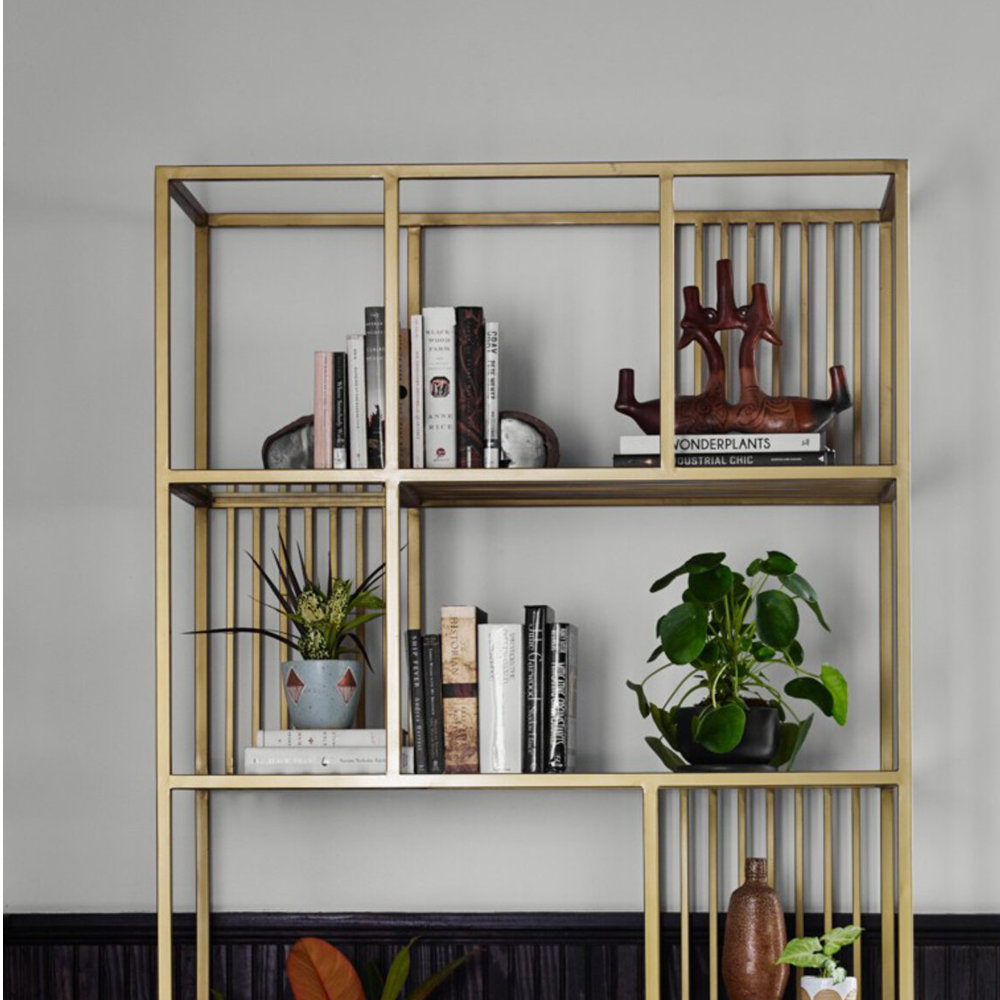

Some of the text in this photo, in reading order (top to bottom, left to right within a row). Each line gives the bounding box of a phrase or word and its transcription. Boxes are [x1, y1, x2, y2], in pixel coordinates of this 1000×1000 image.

[677, 456, 754, 466] DUSTRIAL CHIC
[411, 635, 419, 657] SHIP
[528, 624, 543, 652] Julie
[412, 660, 420, 688] FEVER
[528, 652, 543, 700] Garwood
